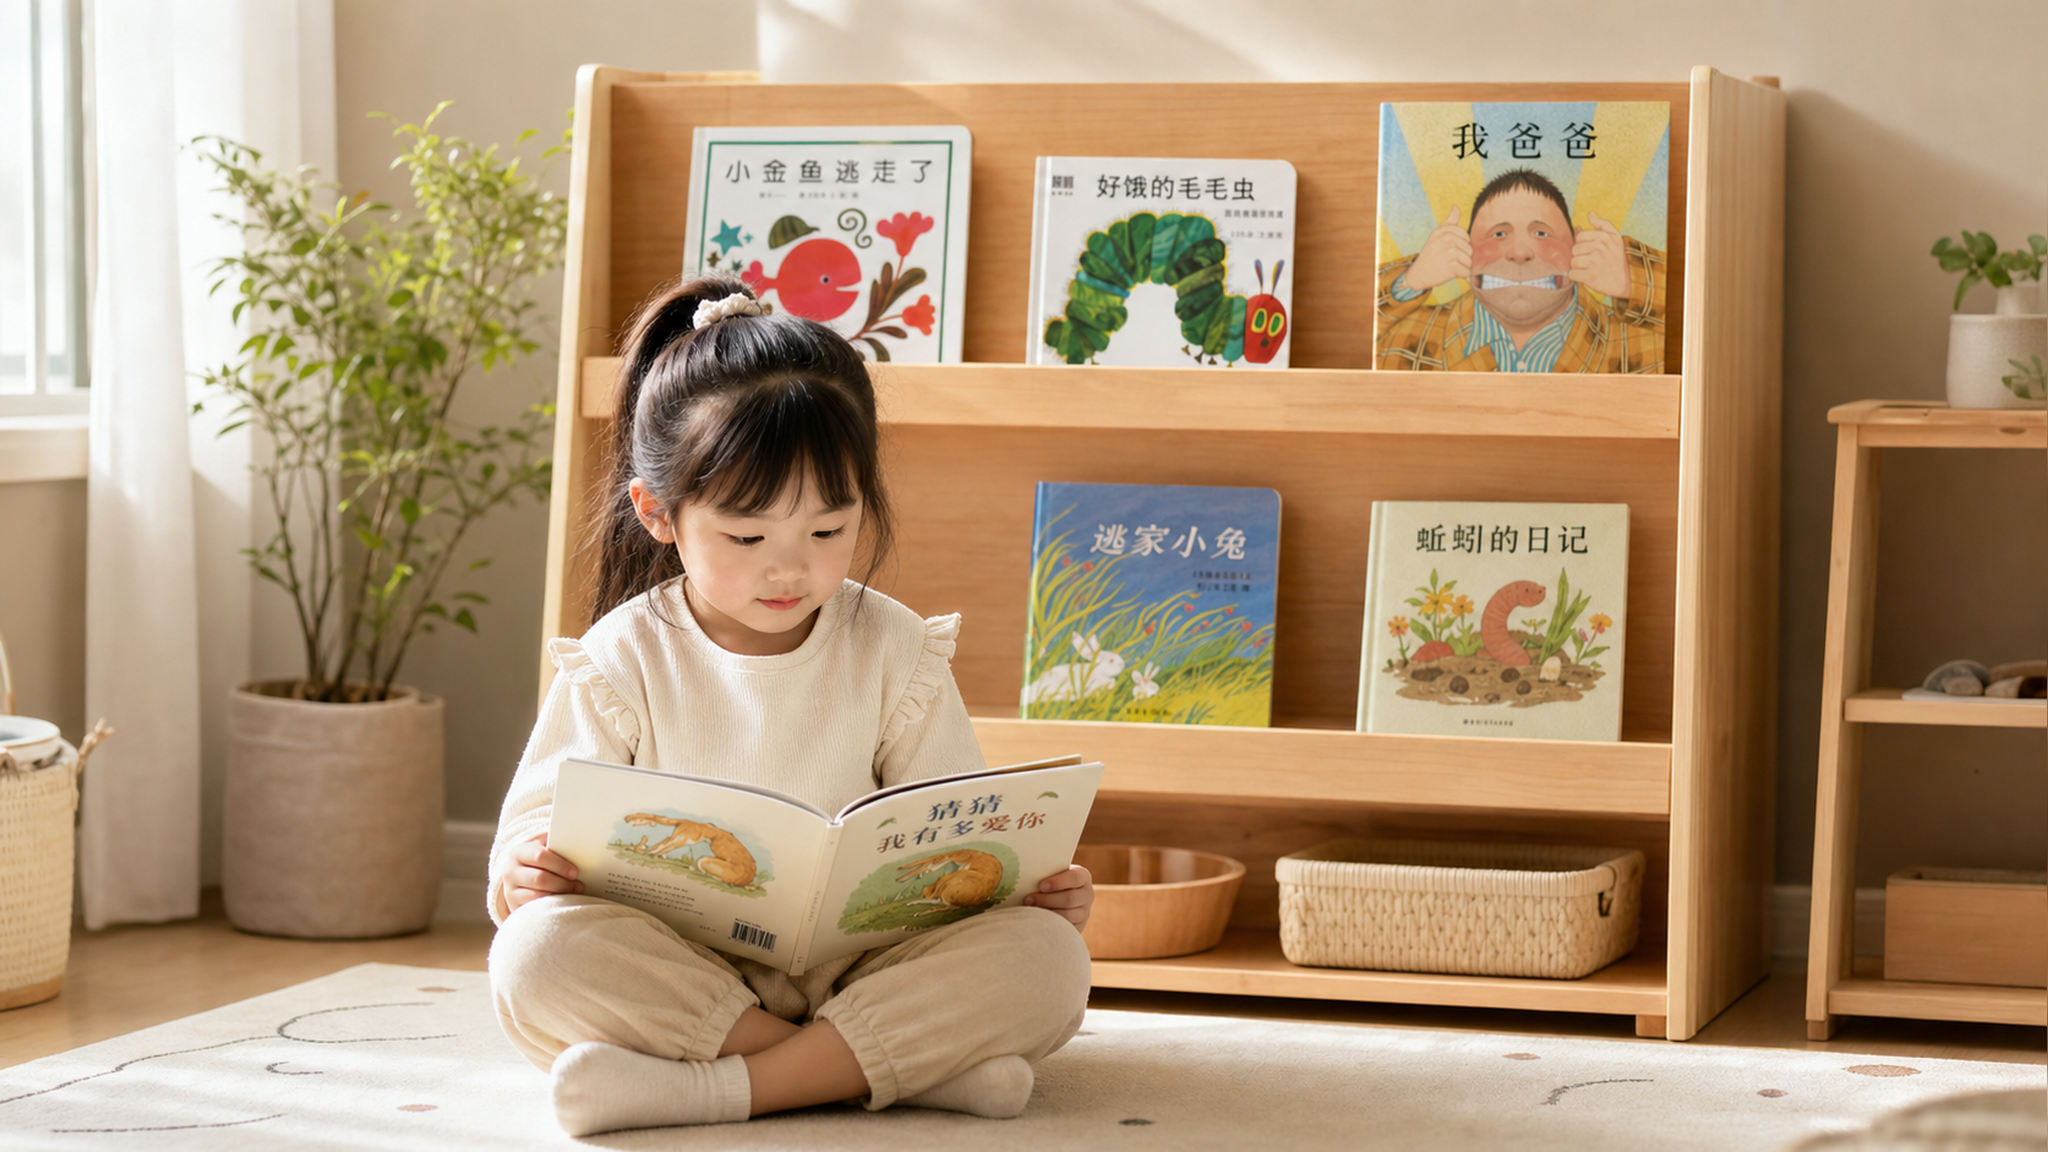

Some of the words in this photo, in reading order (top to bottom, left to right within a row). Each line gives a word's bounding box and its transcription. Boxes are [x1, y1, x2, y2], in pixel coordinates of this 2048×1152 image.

[1452, 121, 1598, 160] 我爸爸
[724, 159, 933, 184] 小金鱼逃走了
[1097, 174, 1255, 202] 好饿的毛毛虫
[1090, 523, 1247, 560] 逃家小兔
[1416, 523, 1589, 555] 蚯蚓的日记
[927, 795, 1003, 822] 猜猜
